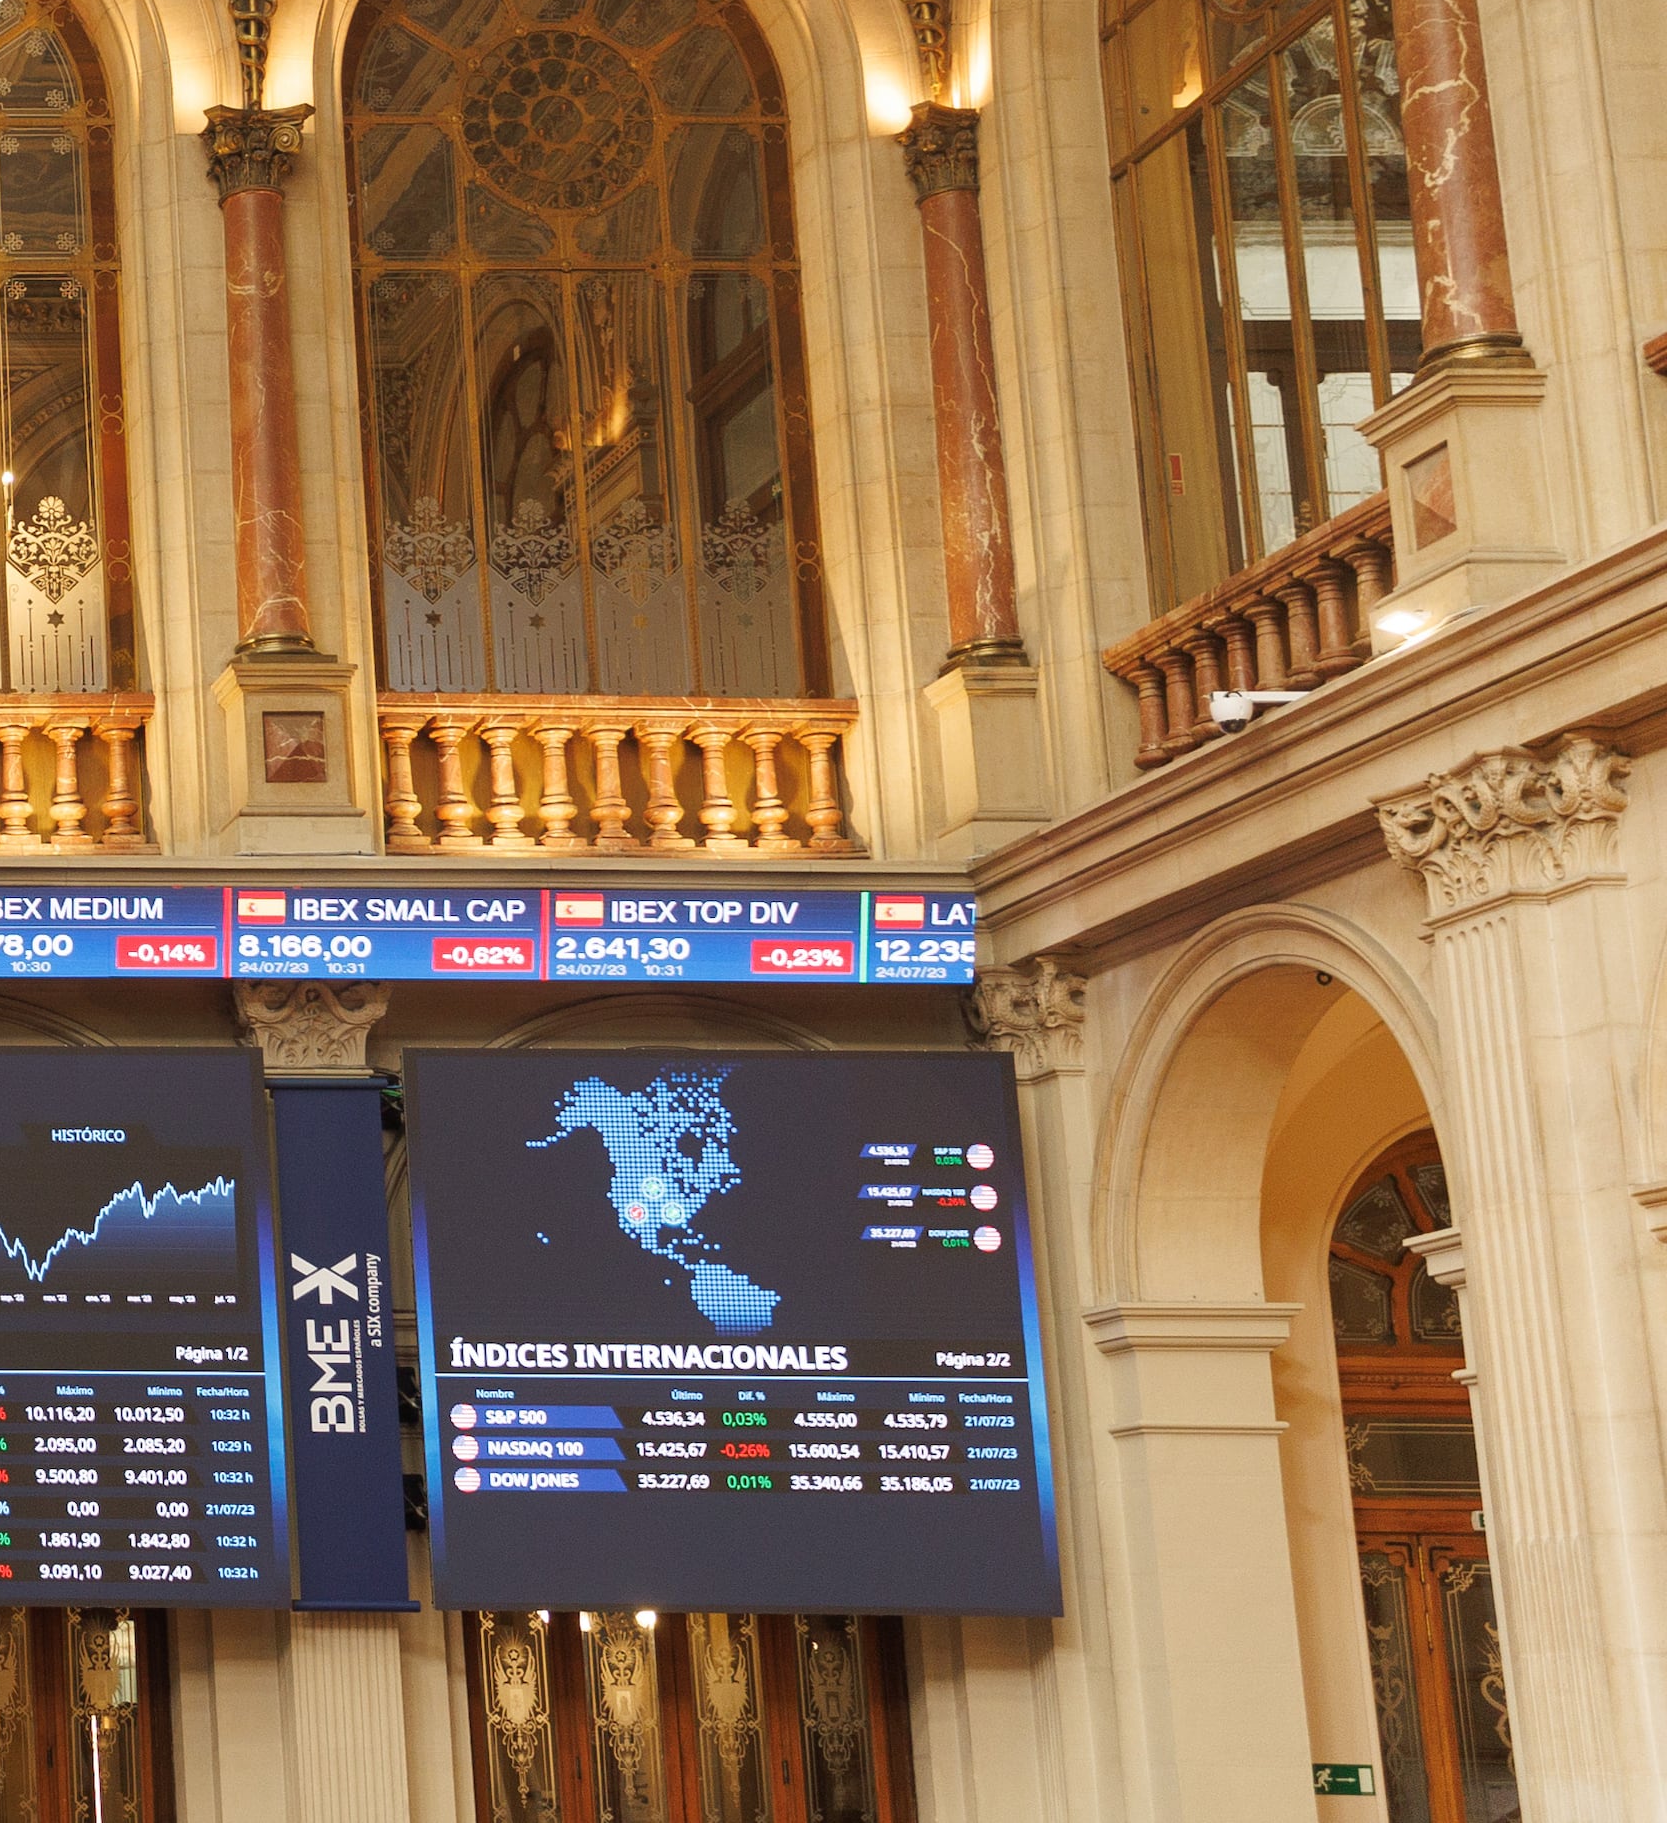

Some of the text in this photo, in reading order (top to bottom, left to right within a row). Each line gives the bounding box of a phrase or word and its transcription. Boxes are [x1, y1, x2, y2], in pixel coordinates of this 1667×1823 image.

[50, 898, 163, 920] MEDIUM
[294, 899, 526, 922] IBEX SMALL CAP
[612, 901, 798, 924] IBEX TOP DIV
[128, 944, 205, 964] -0,14%
[239, 935, 371, 961] 8.166,00
[442, 947, 524, 966] -0,62%
[556, 937, 690, 963] 2.641,30
[761, 949, 843, 968] -0,23%
[52, 1127, 125, 1142] HISTÓRICO
[366, 1252, 383, 1348] a SIX company
[176, 1346, 248, 1363] Página 1/2
[450, 1337, 848, 1370] ÍNDICES INTERNACIONALES
[936, 1352, 1011, 1369] Página 2/2
[305, 1318, 355, 1433] BME
[486, 1410, 947, 1429] S&P 500 4.536,34 0,03% 4.555,00 4.535,79
[488, 1441, 949, 1461] NASDAQ 100 15.425,67 -0,26% 15.600,54 15.410,57
[490, 1473, 710, 1490] DOW JONES 35.227,69
